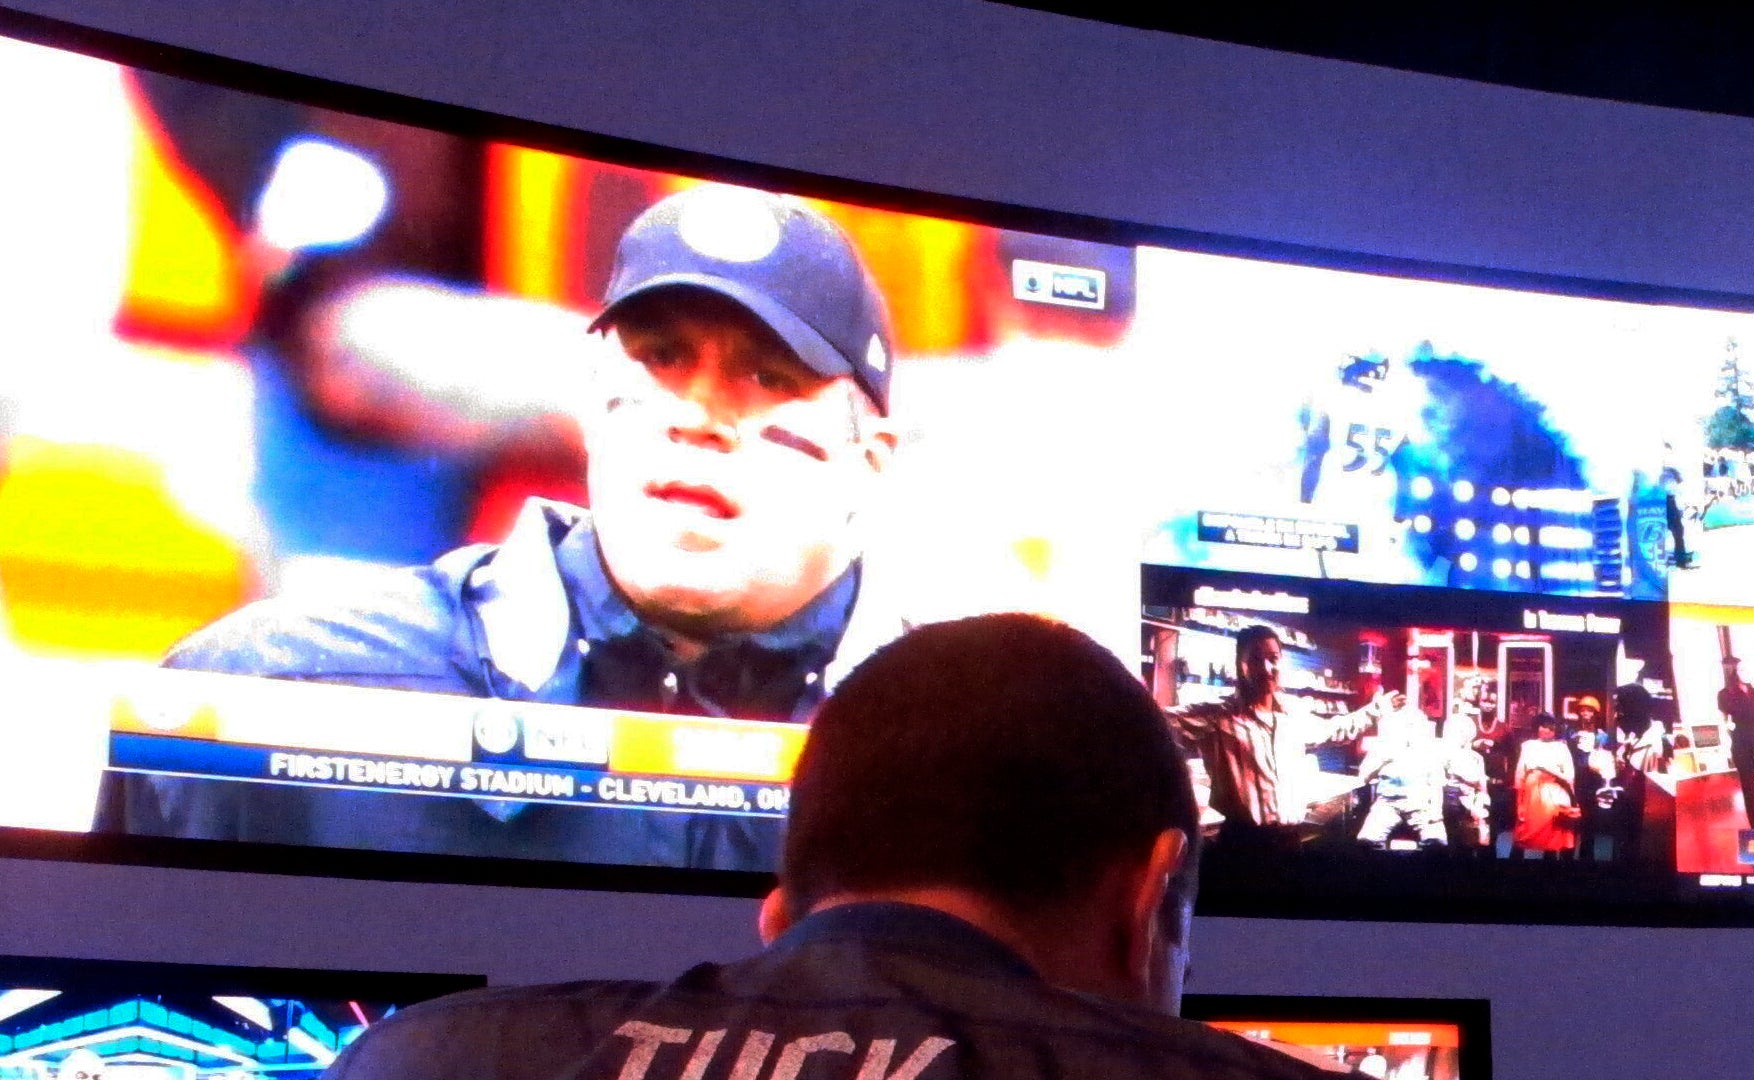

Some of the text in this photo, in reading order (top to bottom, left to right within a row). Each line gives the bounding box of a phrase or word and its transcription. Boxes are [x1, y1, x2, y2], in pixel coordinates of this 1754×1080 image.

[1342, 423, 1391, 476] 55
[269, 752, 456, 789] FIRSTENERGY
[459, 767, 574, 798] STADIUM
[598, 777, 752, 812] CLEVELAND,
